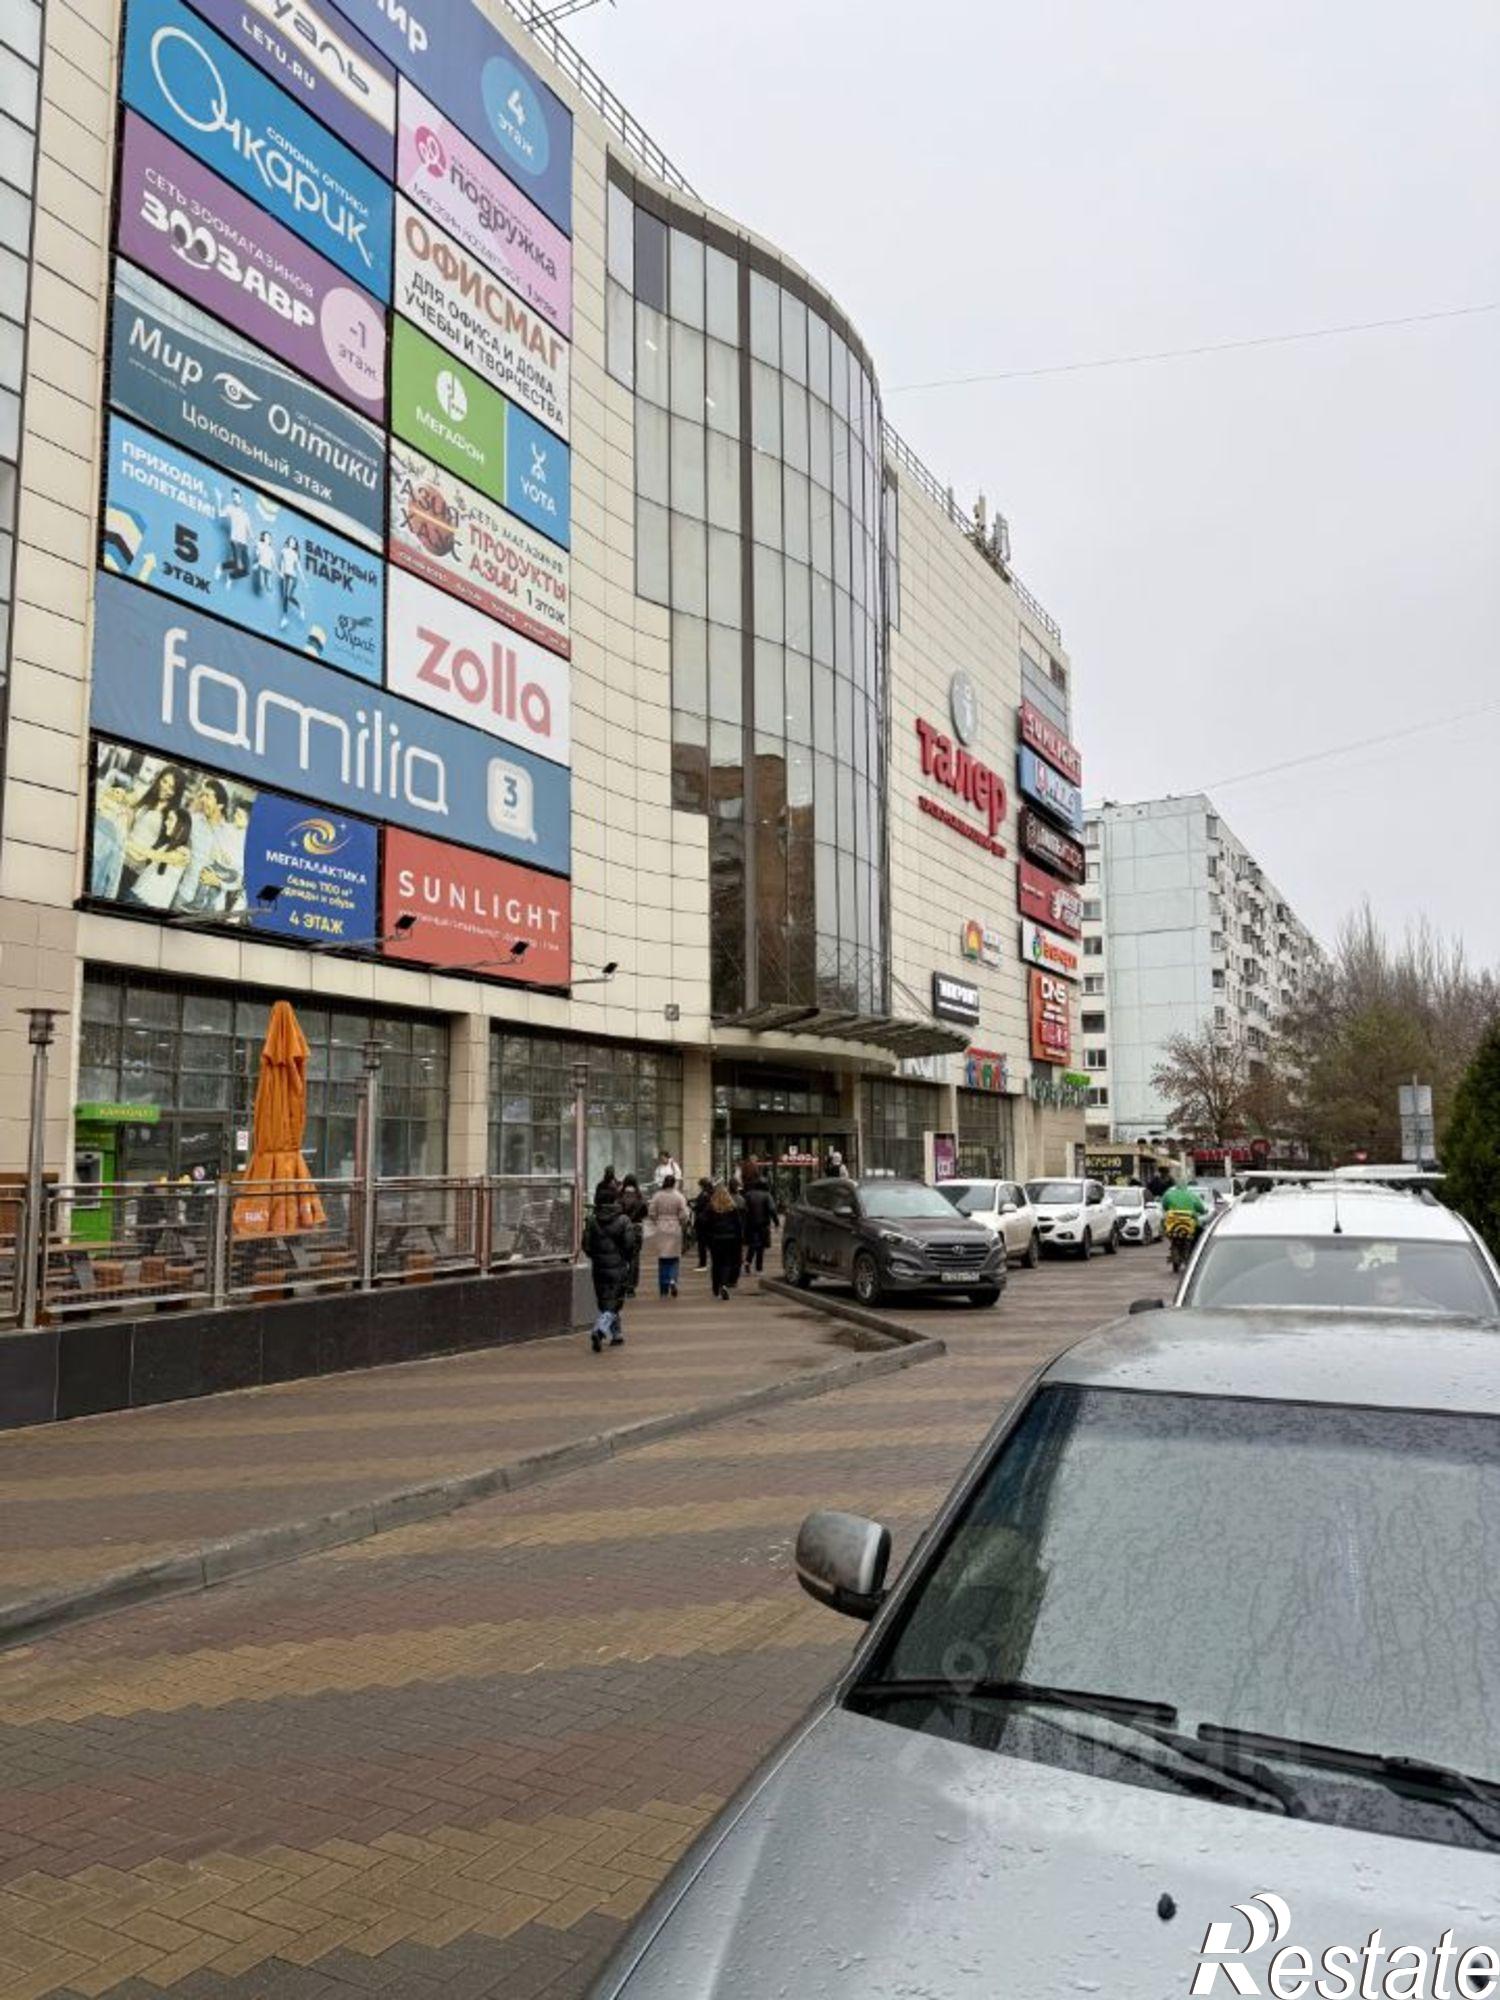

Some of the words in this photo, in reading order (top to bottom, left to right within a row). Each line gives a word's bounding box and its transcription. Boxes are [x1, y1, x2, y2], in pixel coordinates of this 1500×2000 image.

[242, 15, 316, 90] LETU.RU
[376, 0, 428, 54] ир
[506, 88, 526, 126] 4
[150, 25, 372, 268] Очкарик
[498, 114, 535, 160] этаж
[266, 126, 320, 178] салоны
[322, 172, 369, 217] оптики
[144, 167, 187, 206] СЕТЬ
[190, 199, 315, 298] ЗООМАГАЗИНОВ
[450, 163, 558, 281] подружка
[140, 190, 316, 328] ЗООЗАВР
[404, 216, 564, 372] ОФИСМАГ
[411, 271, 446, 305] ДЛЯ
[449, 300, 500, 350] ОФИСА
[503, 346, 514, 365] И
[338, 343, 378, 382] этаж
[350, 320, 366, 350] -1
[404, 285, 461, 345] УЧЕБЫ
[463, 335, 474, 355] И
[477, 343, 564, 426] ТВОРЧЕСТВА
[129, 315, 204, 387] Мир
[267, 401, 379, 491] Оптики
[181, 400, 291, 478] Цокольный
[294, 473, 334, 501] этаж
[122, 459, 217, 520] ПОЛЕТАЕМ!
[520, 474, 557, 517] YOTA
[174, 522, 199, 563] 5
[305, 539, 379, 587] БАТУТНЫЙ
[469, 522, 566, 603] ПРОДУКТЫ
[162, 561, 212, 595] этаж
[305, 556, 356, 594] ПАРК
[469, 553, 519, 597] АЗИИ
[525, 588, 533, 606] 1
[534, 599, 566, 626] этаж
[416, 625, 552, 740] zolla
[161, 627, 449, 817] familia
[503, 775, 518, 808] 3
[265, 849, 368, 886] МЕГАГАЛАКТИКА
[288, 909, 300, 926] 4
[302, 912, 345, 935] ЭТАЖ
[398, 869, 562, 934] SUNLIGHT
[1041, 974, 1068, 1004] DNS
